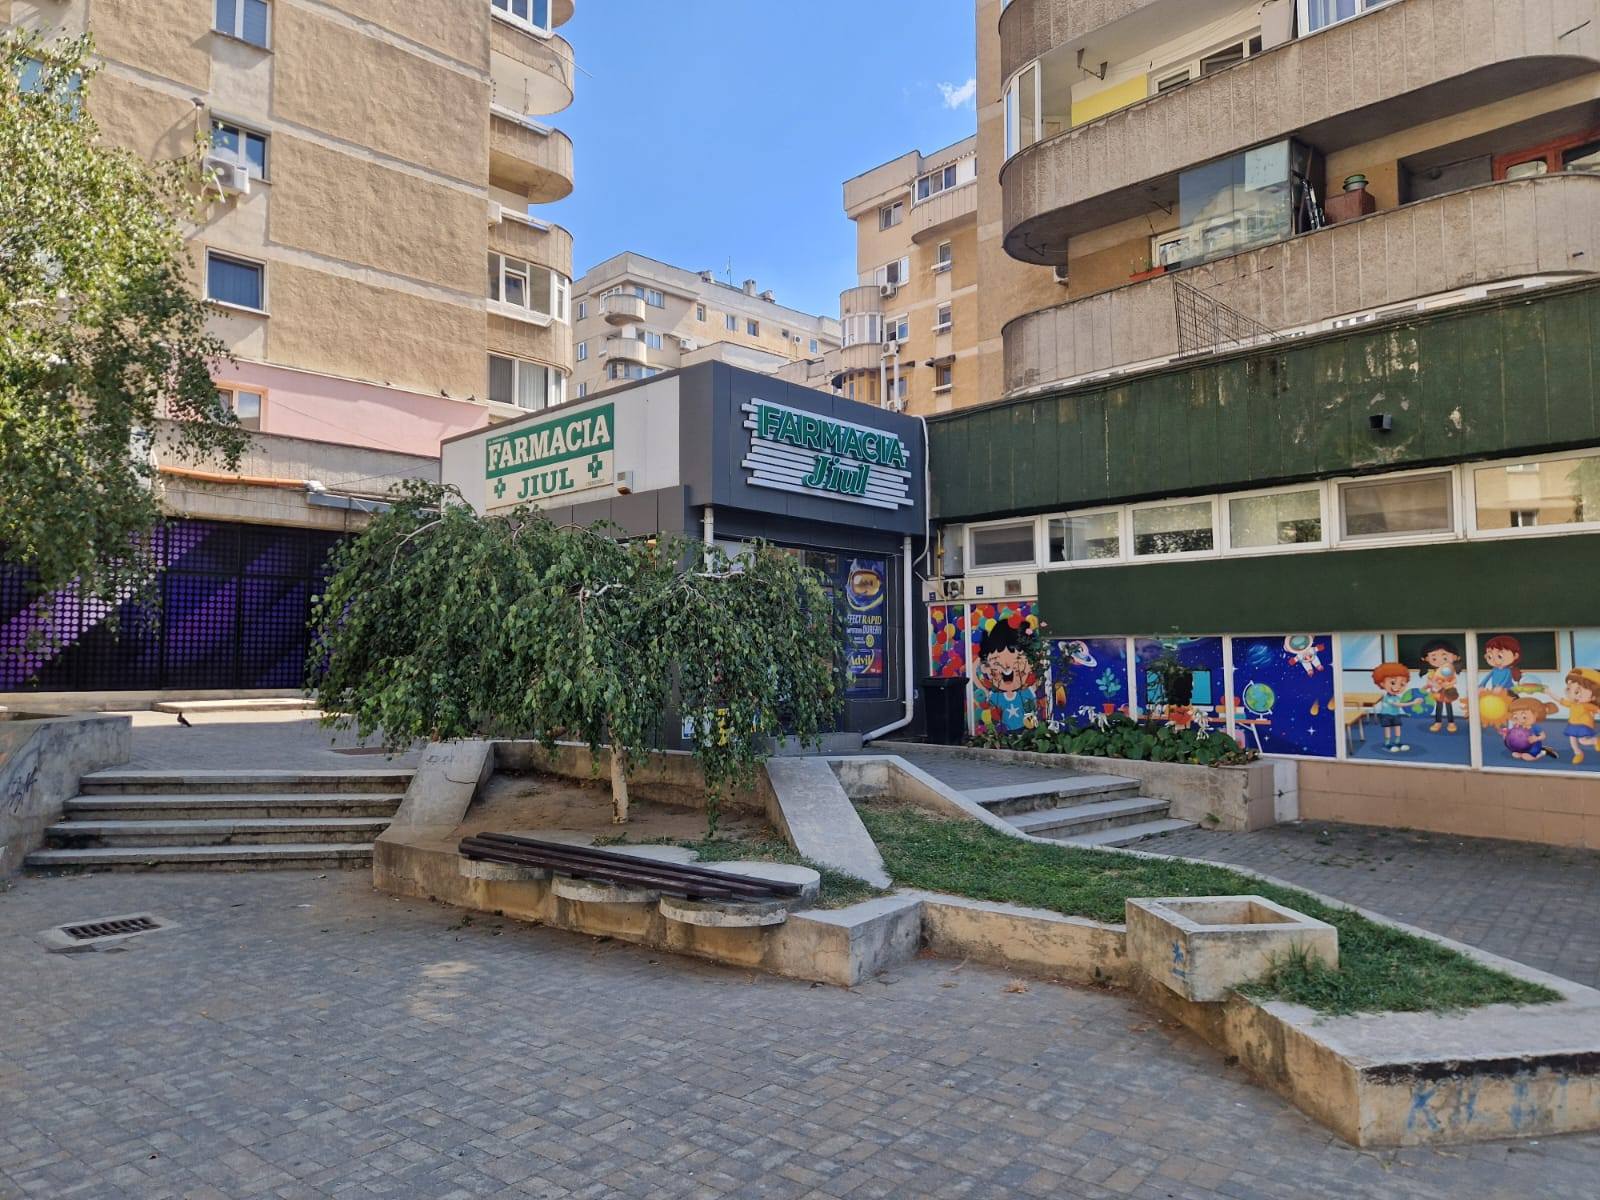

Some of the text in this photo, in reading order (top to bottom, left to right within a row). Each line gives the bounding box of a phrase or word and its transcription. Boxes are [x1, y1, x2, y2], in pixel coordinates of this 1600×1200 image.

[487, 414, 610, 472] FARMACIA
[758, 403, 906, 468] FARMACIA
[517, 467, 575, 499] JIUL
[801, 455, 871, 496] Jiul
